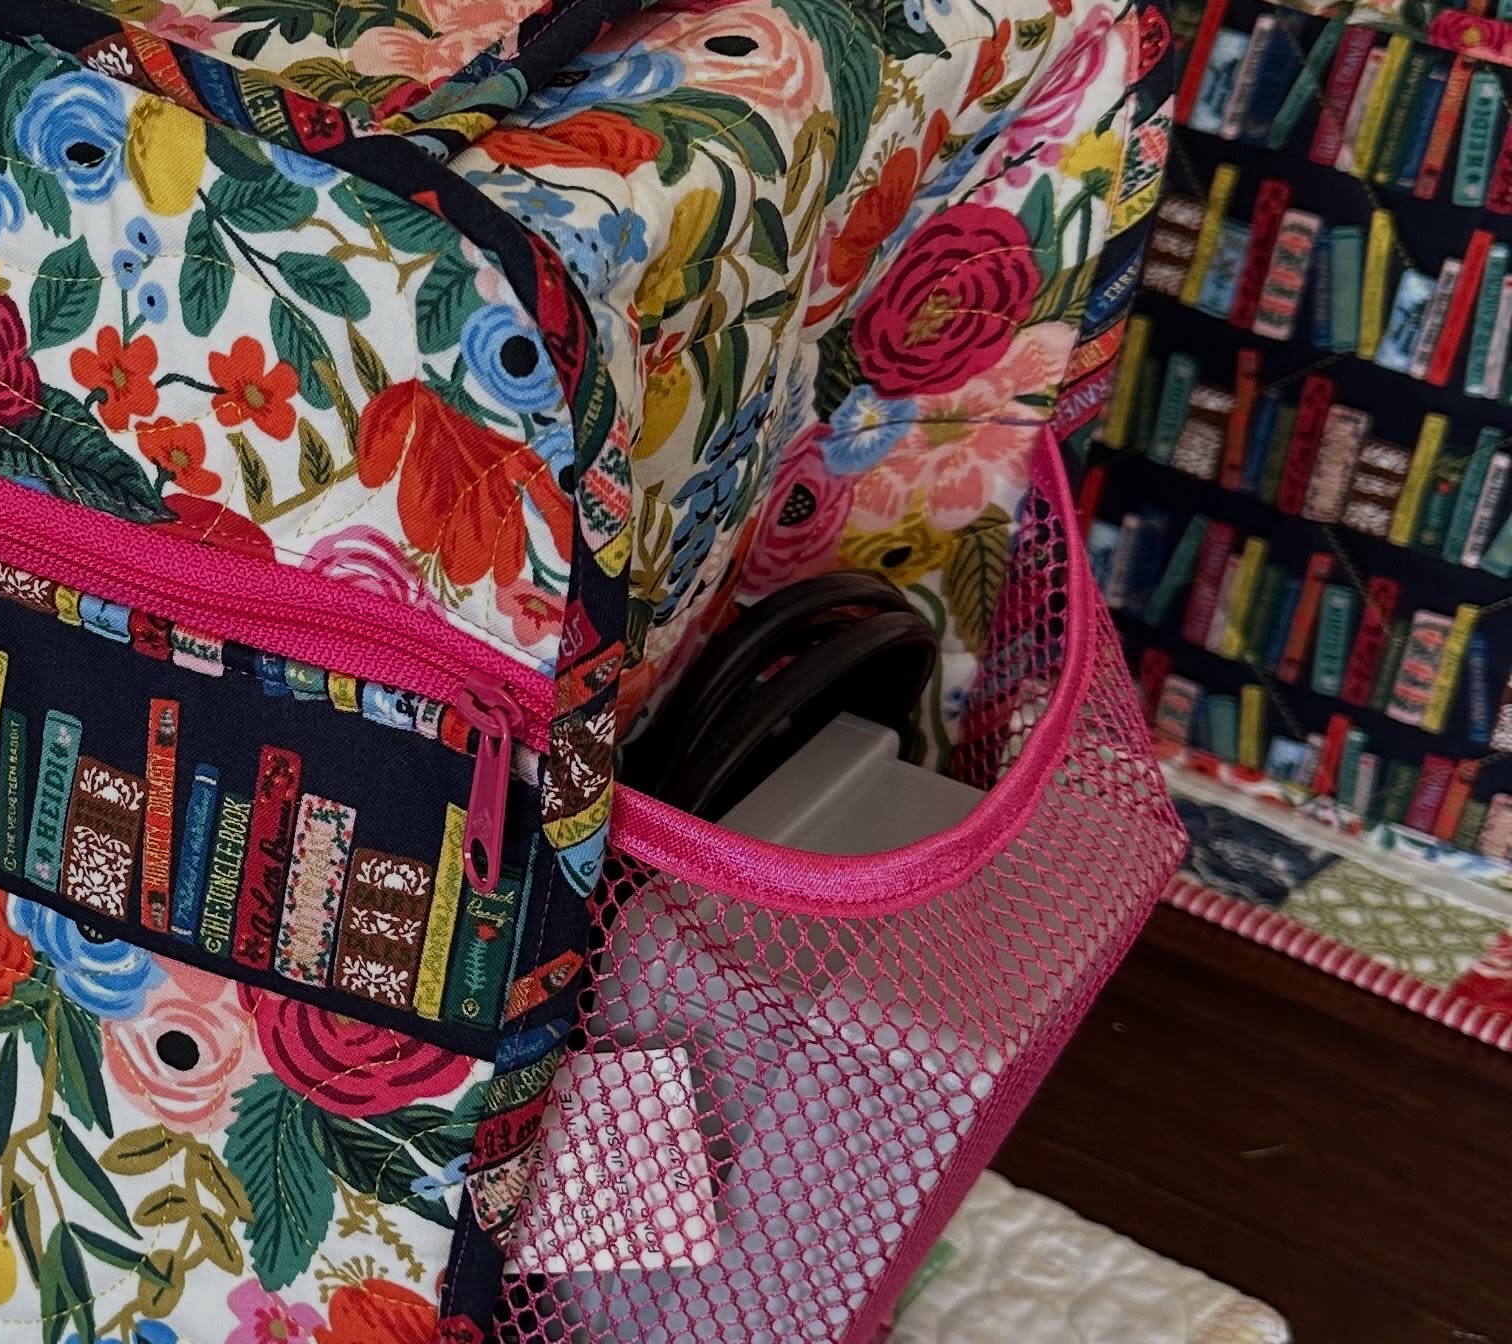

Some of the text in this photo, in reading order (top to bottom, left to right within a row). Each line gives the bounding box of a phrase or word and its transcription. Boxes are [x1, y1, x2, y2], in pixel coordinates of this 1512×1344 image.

[36, 754, 68, 839] HEIDI
[219, 797, 251, 846] BOOK
[6, 832, 16, 853] THE
[144, 825, 171, 886] HUMPTY
